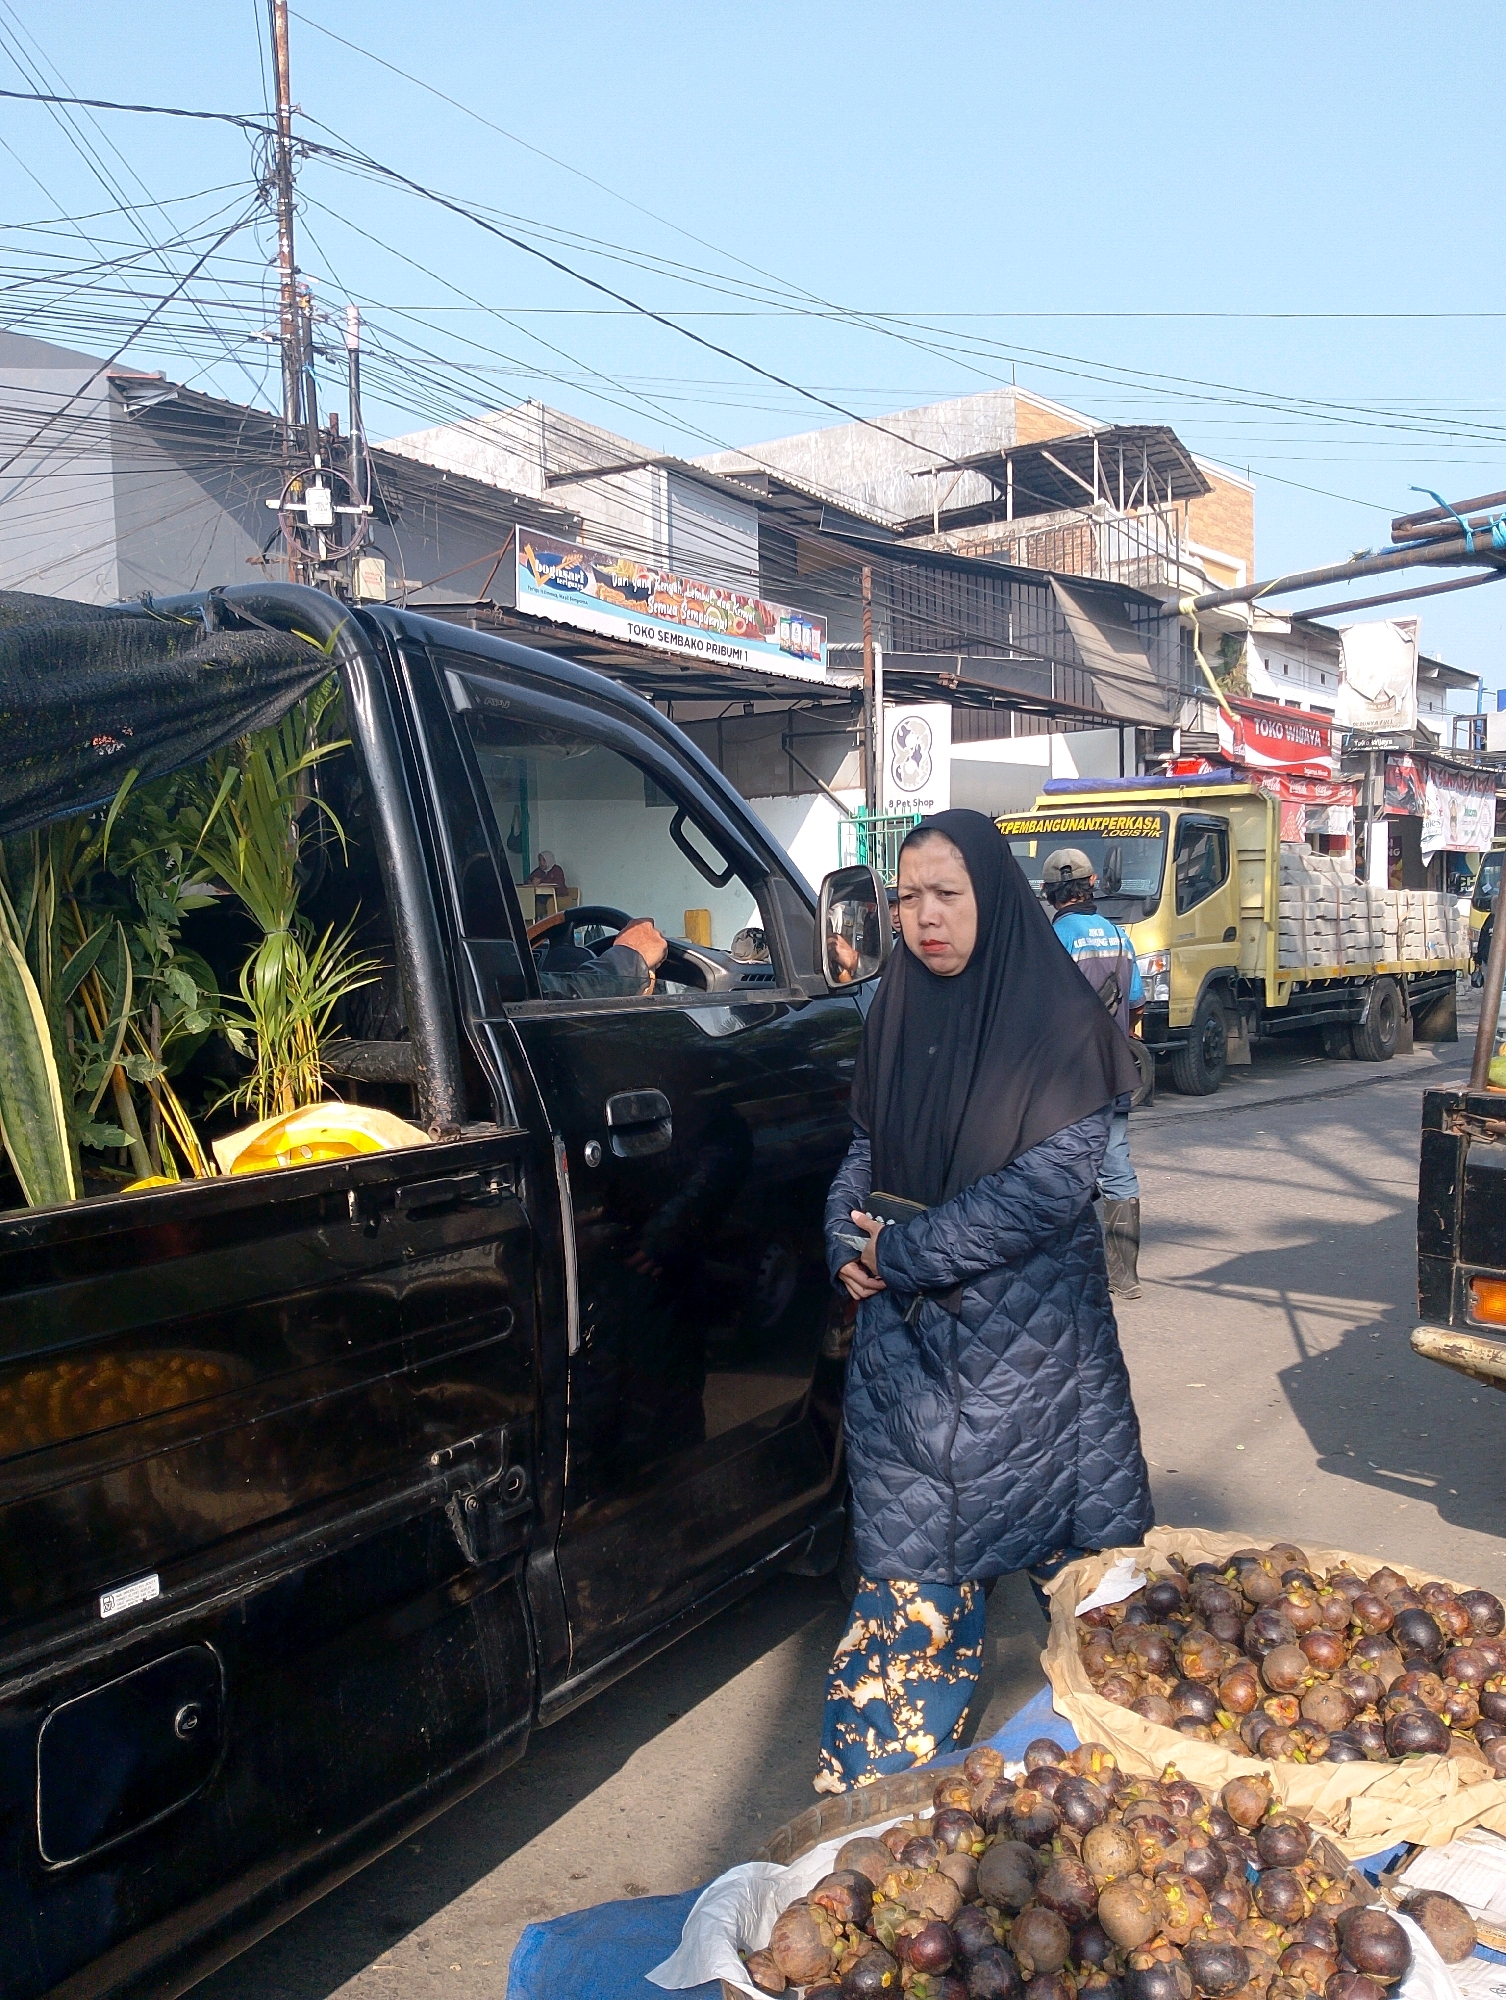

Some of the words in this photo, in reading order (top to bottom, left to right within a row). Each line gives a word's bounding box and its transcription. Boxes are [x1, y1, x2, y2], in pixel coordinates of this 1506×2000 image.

[647, 596, 679, 616] Semua
[627, 622, 655, 640] TOKO
[657, 630, 705, 652] SEMBAKO
[705, 641, 743, 661] PRIBUMI
[1253, 717, 1284, 740] TOKO
[1285, 723, 1322, 748] WIJAYA
[888, 799, 894, 808] 8
[896, 798, 911, 808] Pet
[912, 797, 934, 809] Shop
[1101, 829, 1164, 838] LOGISTIK
